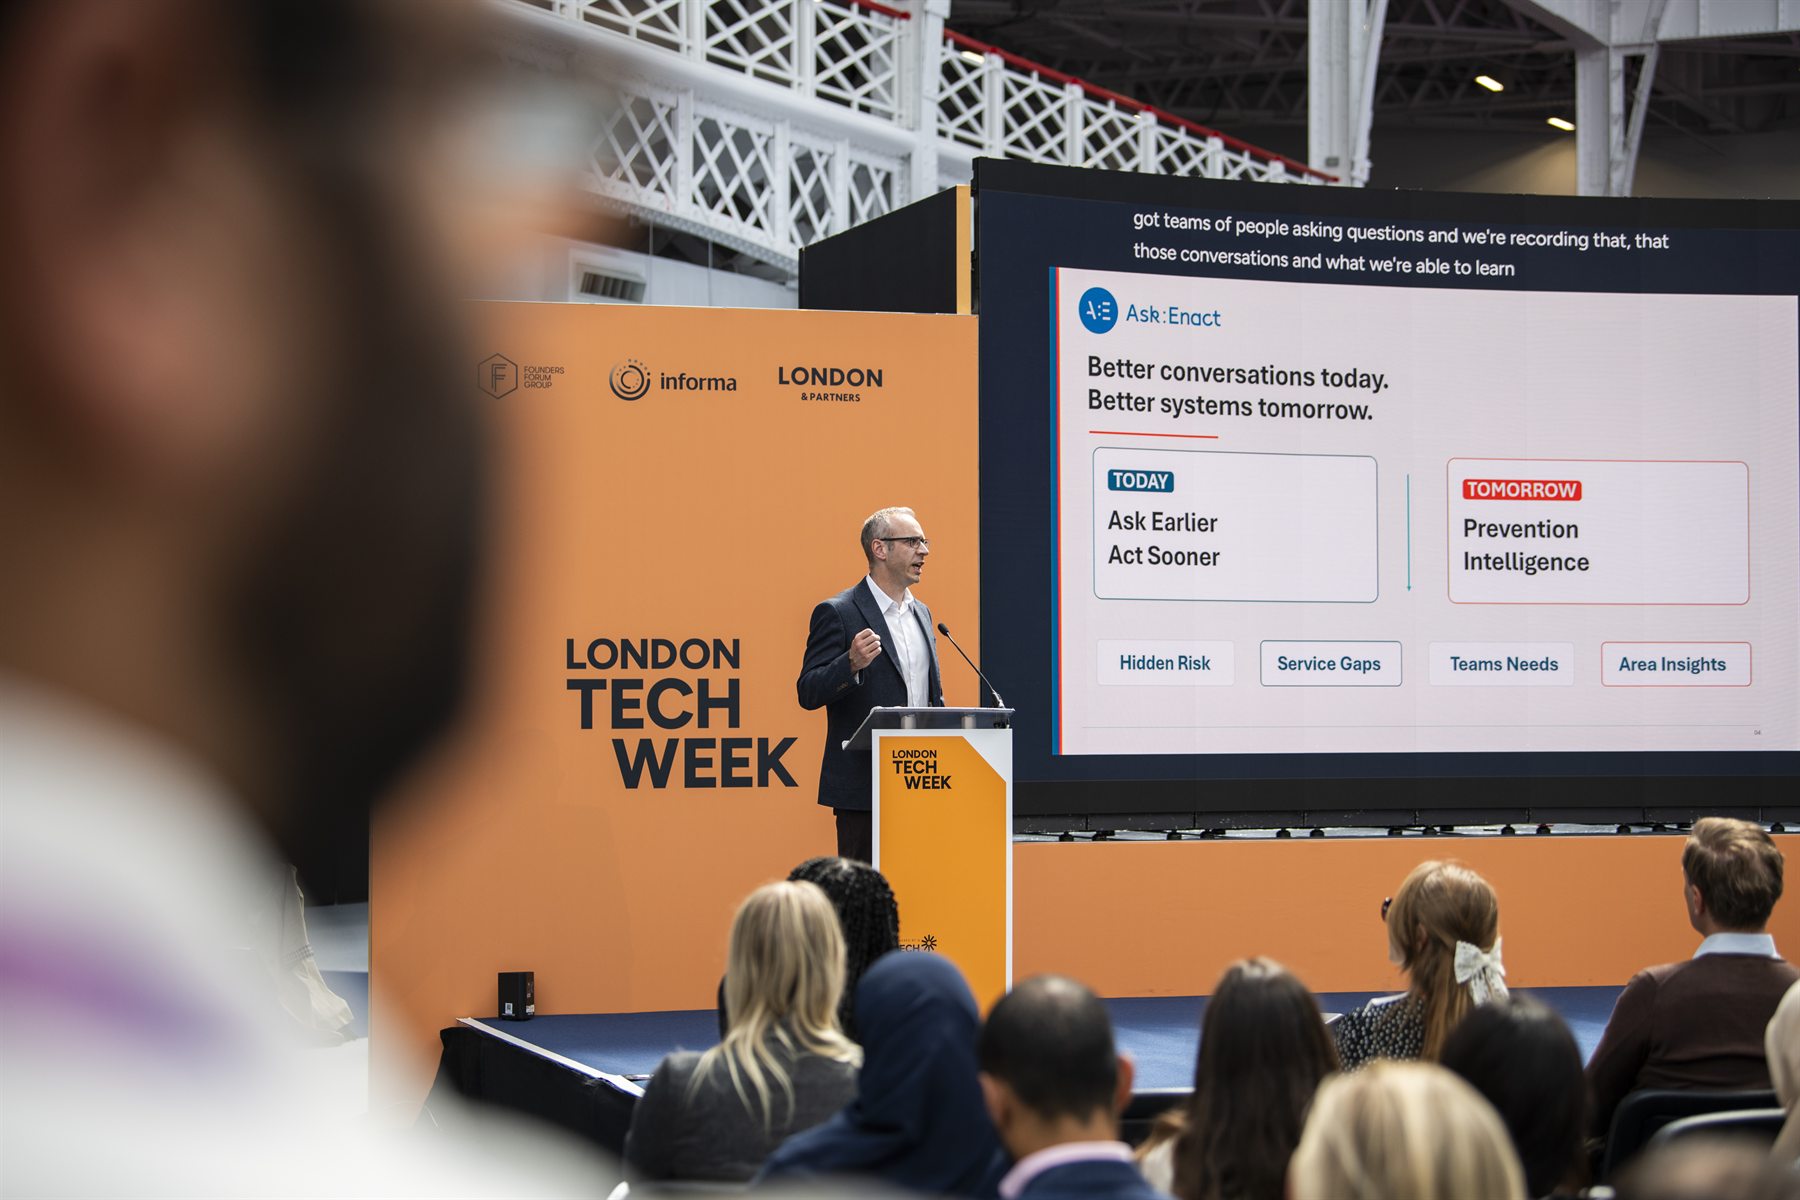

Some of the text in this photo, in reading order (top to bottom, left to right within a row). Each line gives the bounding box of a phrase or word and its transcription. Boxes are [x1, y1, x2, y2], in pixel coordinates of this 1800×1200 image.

[1133, 211, 1670, 252] got teams of people asking questions and we're recording that, that
[1133, 241, 1515, 277] those conversations and what we're able to learn
[523, 366, 565, 375] FOUNDERS
[778, 366, 883, 388] LONDON
[1088, 355, 1389, 394] Better conversations today.
[523, 381, 552, 389] GROUP
[660, 371, 737, 392] informa
[800, 392, 861, 403] & PARTNERS
[1088, 388, 1373, 421] Better systems tomorrow.
[1113, 472, 1169, 490] TODAY
[1467, 481, 1578, 498] TOMORROW
[1107, 510, 1218, 533] Ask Earlier
[1464, 518, 1579, 539] Prevention
[1107, 544, 1221, 567] Act Sooner
[1464, 551, 1590, 576] Intelligence
[566, 637, 740, 670] LONDON
[1120, 655, 1211, 671] Hidden Risk
[1449, 656, 1559, 672] Teams Needs
[1277, 655, 1381, 675] Service Gaps
[1618, 656, 1727, 675] Area Insights
[566, 677, 741, 730] TECH
[611, 736, 799, 790] WEEK
[892, 750, 937, 759] LONDON
[892, 760, 937, 774] TECH
[904, 775, 952, 790] WEEK
